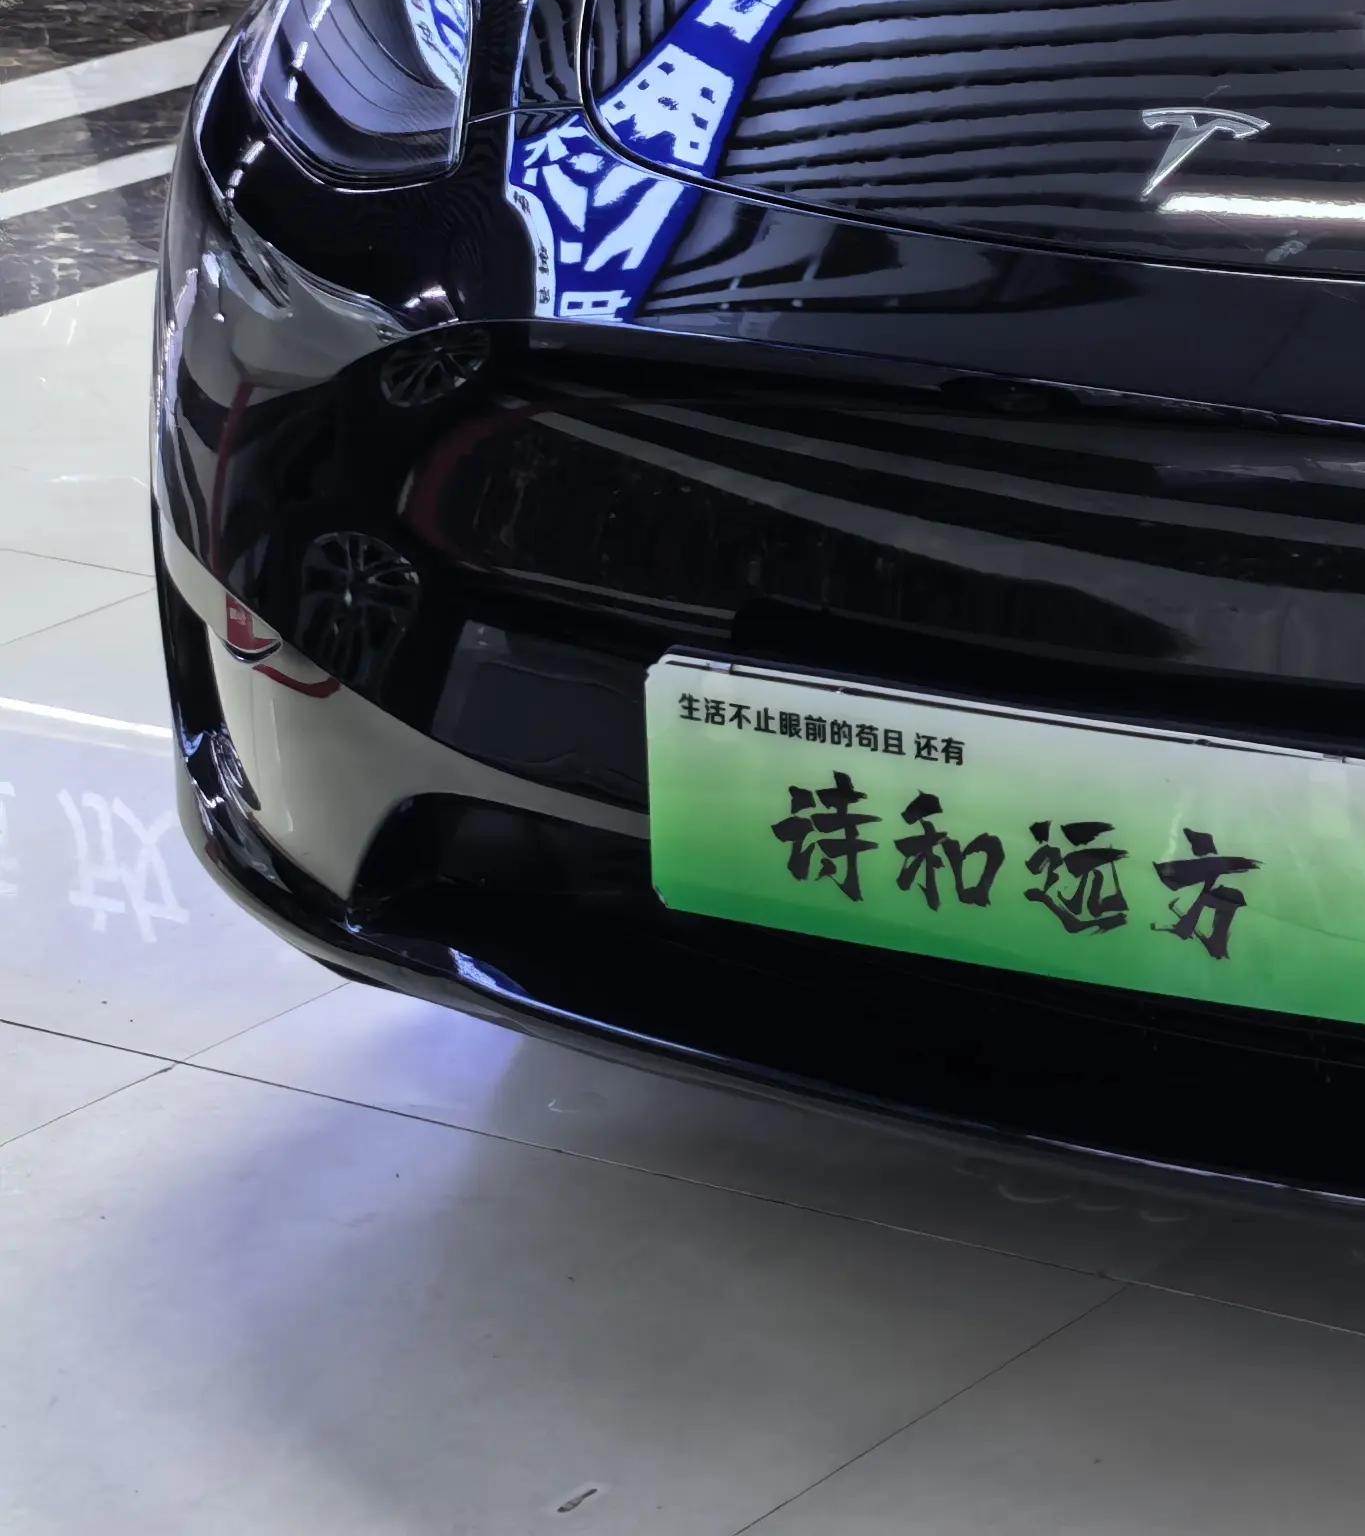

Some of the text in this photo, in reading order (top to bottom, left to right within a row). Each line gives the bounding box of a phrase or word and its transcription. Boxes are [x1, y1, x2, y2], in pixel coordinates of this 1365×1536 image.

[677, 692, 965, 766] 生活不止眼前的苟且 还有
[771, 770, 1265, 961] 诗和远方
